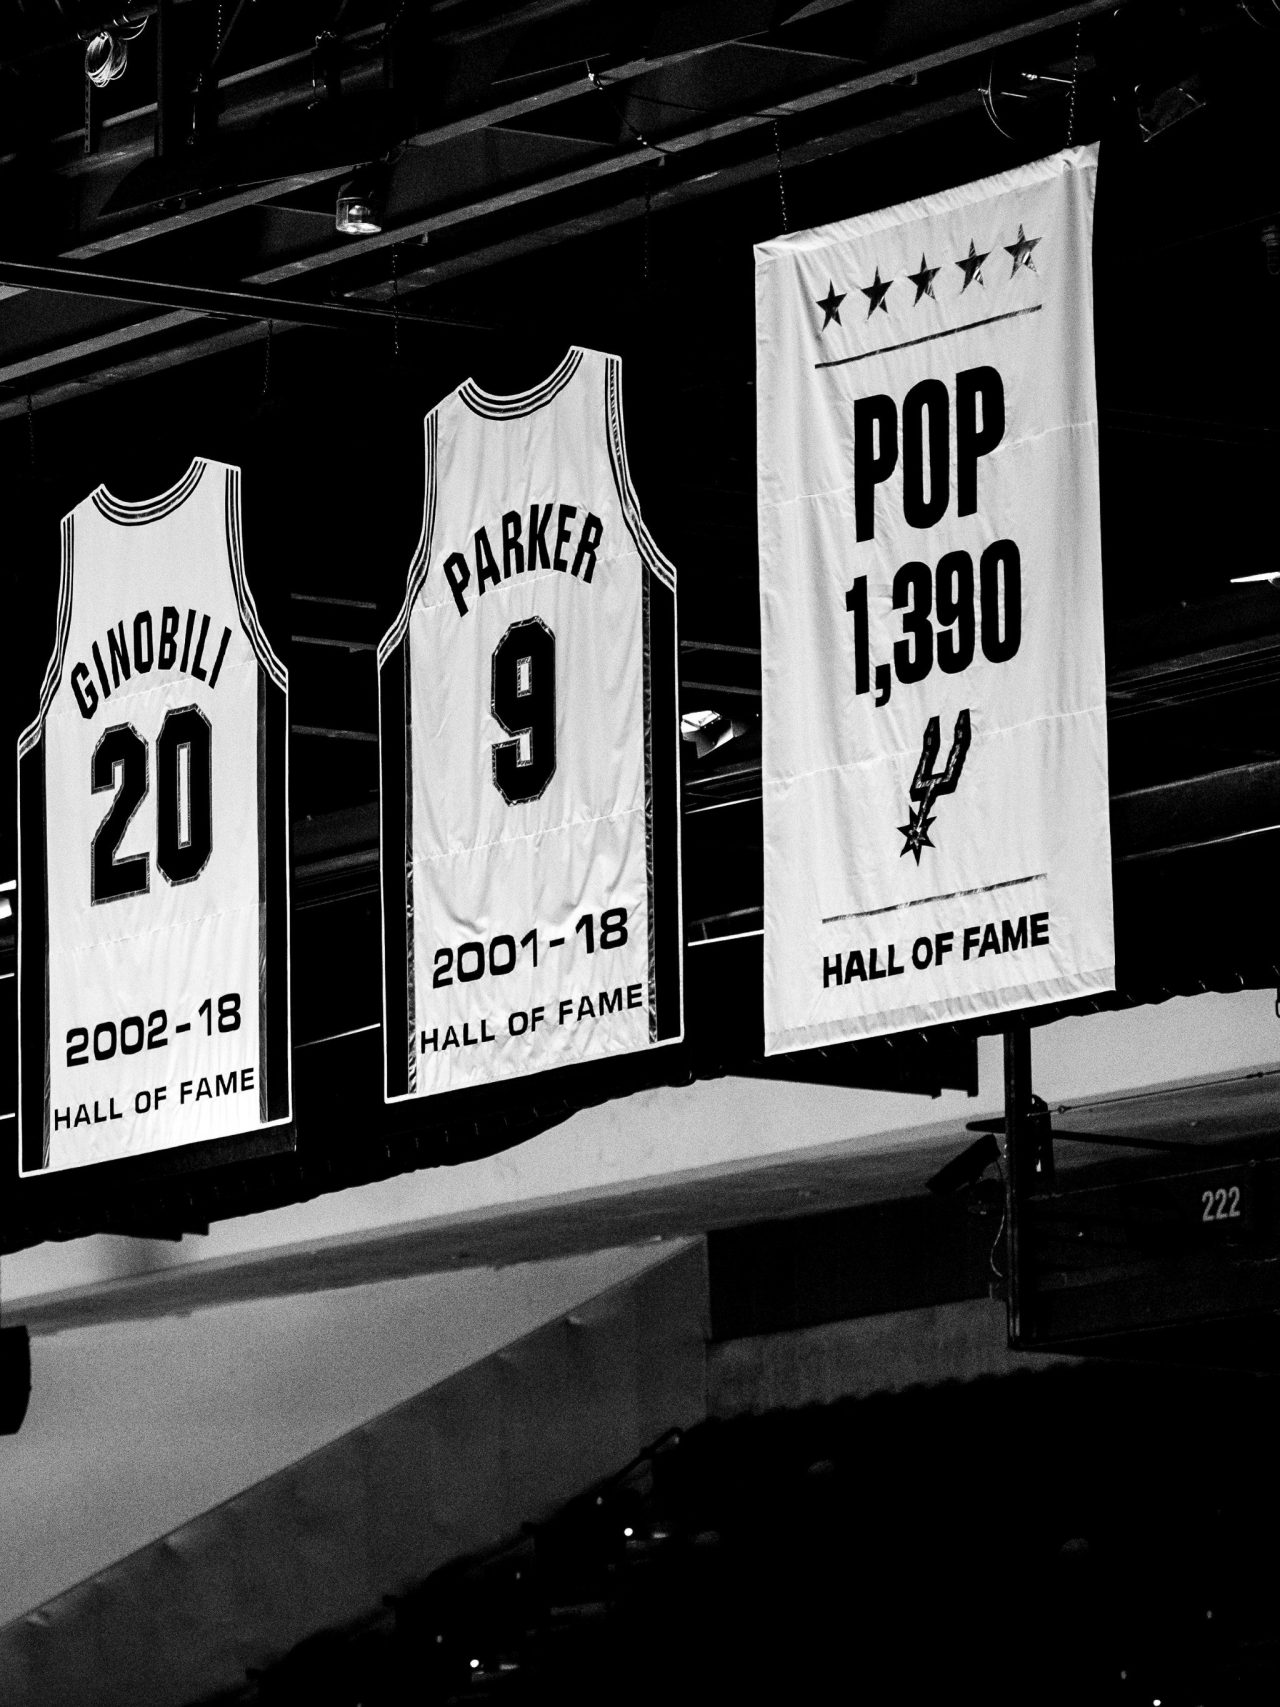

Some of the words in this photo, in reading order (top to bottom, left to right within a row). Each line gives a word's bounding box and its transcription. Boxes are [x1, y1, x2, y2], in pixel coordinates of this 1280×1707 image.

[854, 366, 1005, 542] POP
[443, 504, 603, 617] PARKER
[71, 606, 232, 719] GINOBILI
[846, 539, 1021, 707] 1,390
[491, 616, 556, 806] 9
[91, 703, 212, 906] 20
[433, 908, 628, 988] 2001-18
[824, 945, 904, 988] HALL
[912, 932, 954, 969] OF
[963, 912, 1049, 960] FAME
[67, 993, 240, 1067] 2002-18
[421, 1020, 495, 1054] HALL
[509, 1007, 544, 1036] OF
[559, 983, 642, 1024] FAME
[55, 1098, 122, 1130] HALL
[135, 1086, 166, 1113] OF
[181, 1068, 254, 1104] FAME
[1201, 1186, 1241, 1222] 222
